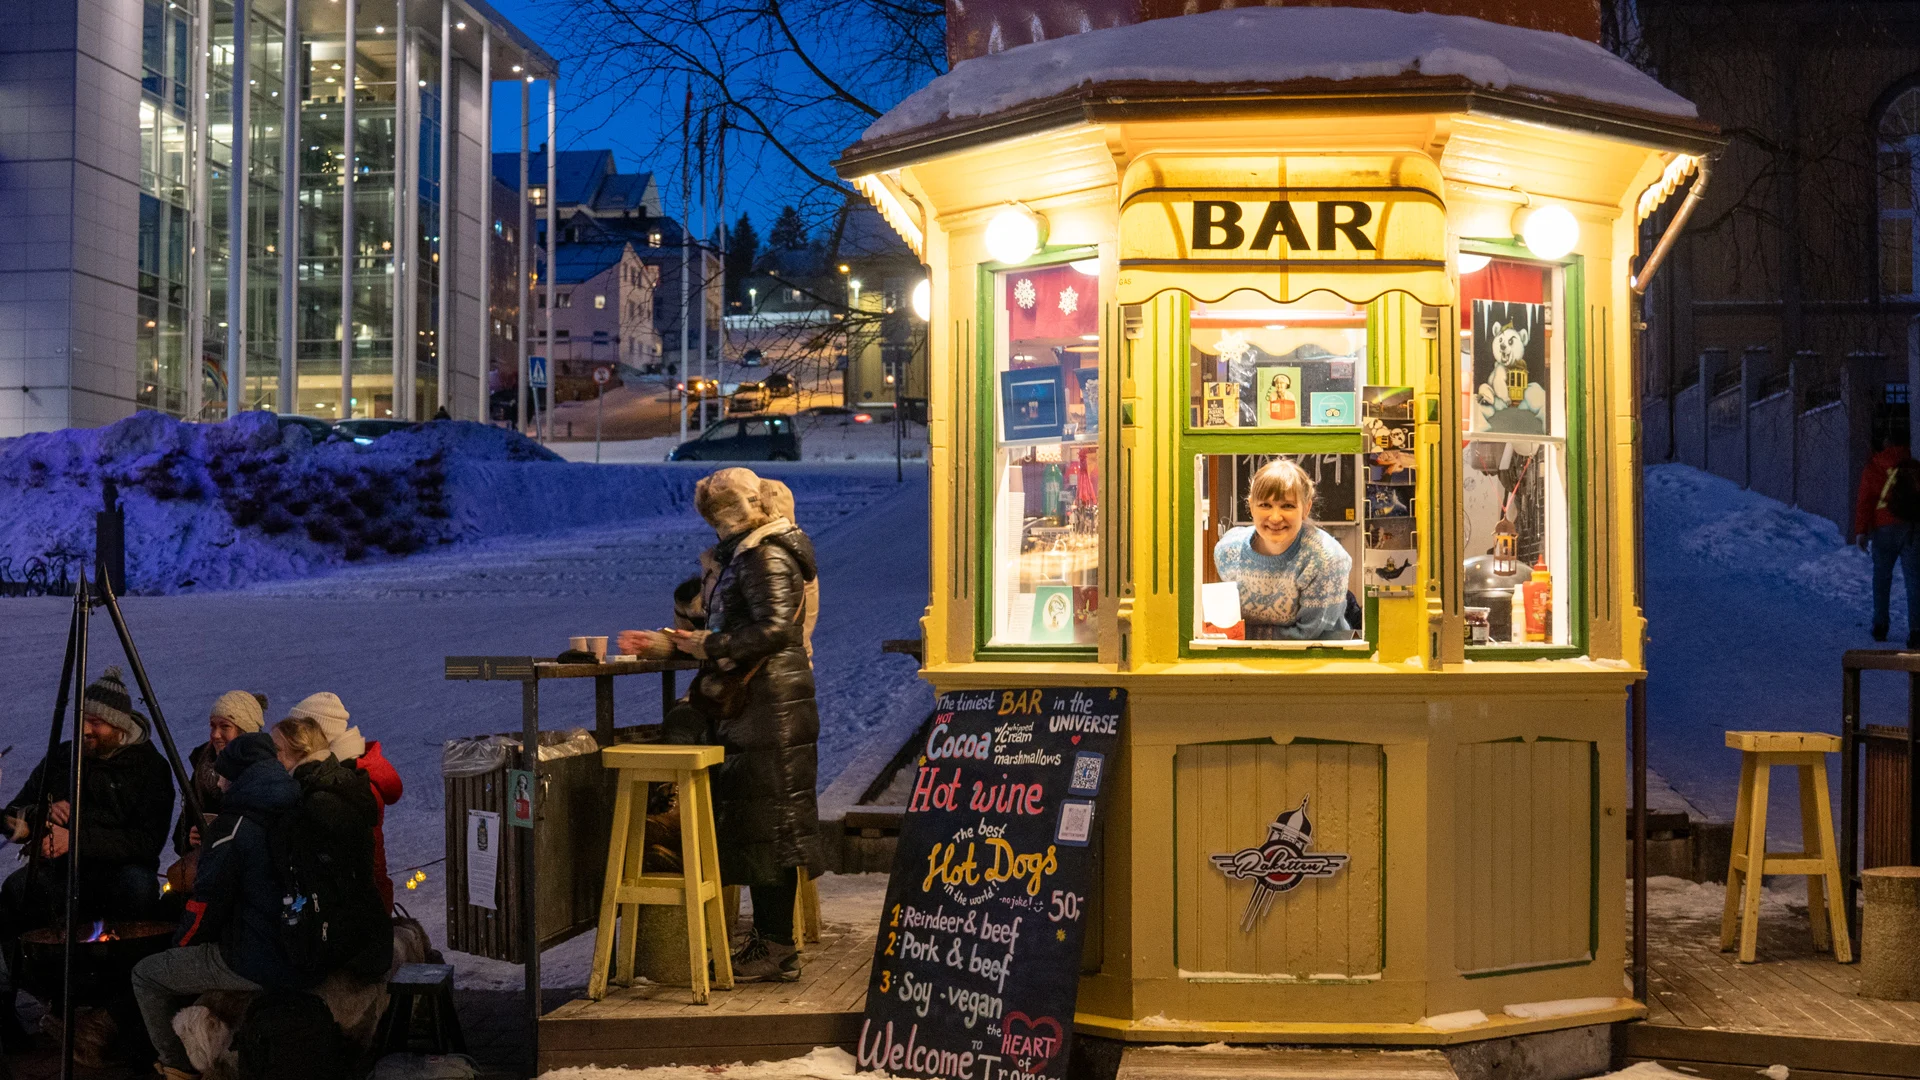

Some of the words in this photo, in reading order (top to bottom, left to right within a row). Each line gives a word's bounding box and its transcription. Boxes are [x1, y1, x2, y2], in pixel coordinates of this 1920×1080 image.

[1192, 200, 1377, 250] BAR
[936, 712, 954, 724] HOT
[937, 694, 954, 712] The
[957, 691, 995, 711] tiniest
[998, 689, 1043, 715] BAR
[1053, 696, 1065, 710] in
[1070, 691, 1093, 715] the
[1049, 714, 1118, 735] UNIVERSE
[926, 724, 992, 761] Cocoa
[994, 744, 1006, 753] or
[994, 749, 1061, 766] marshmallows
[908, 766, 962, 813] Hot
[970, 773, 1044, 815] wine
[952, 827, 974, 844] The
[978, 817, 1008, 838] best
[922, 842, 980, 893] Hot
[984, 837, 1058, 896] Dogs
[1233, 849, 1328, 879] Raketten
[943, 883, 954, 896] in
[954, 891, 967, 906] the
[980, 911, 1023, 955] beef
[900, 931, 940, 963] Pork
[946, 937, 964, 970] &
[968, 943, 1013, 993] beef
[898, 971, 933, 1018] Soy
[857, 1018, 974, 1080] Welcome
[971, 1040, 984, 1050] TO
[986, 1023, 1002, 1038] the
[1001, 1034, 1057, 1058] HEART
[1018, 1057, 1032, 1072] of
